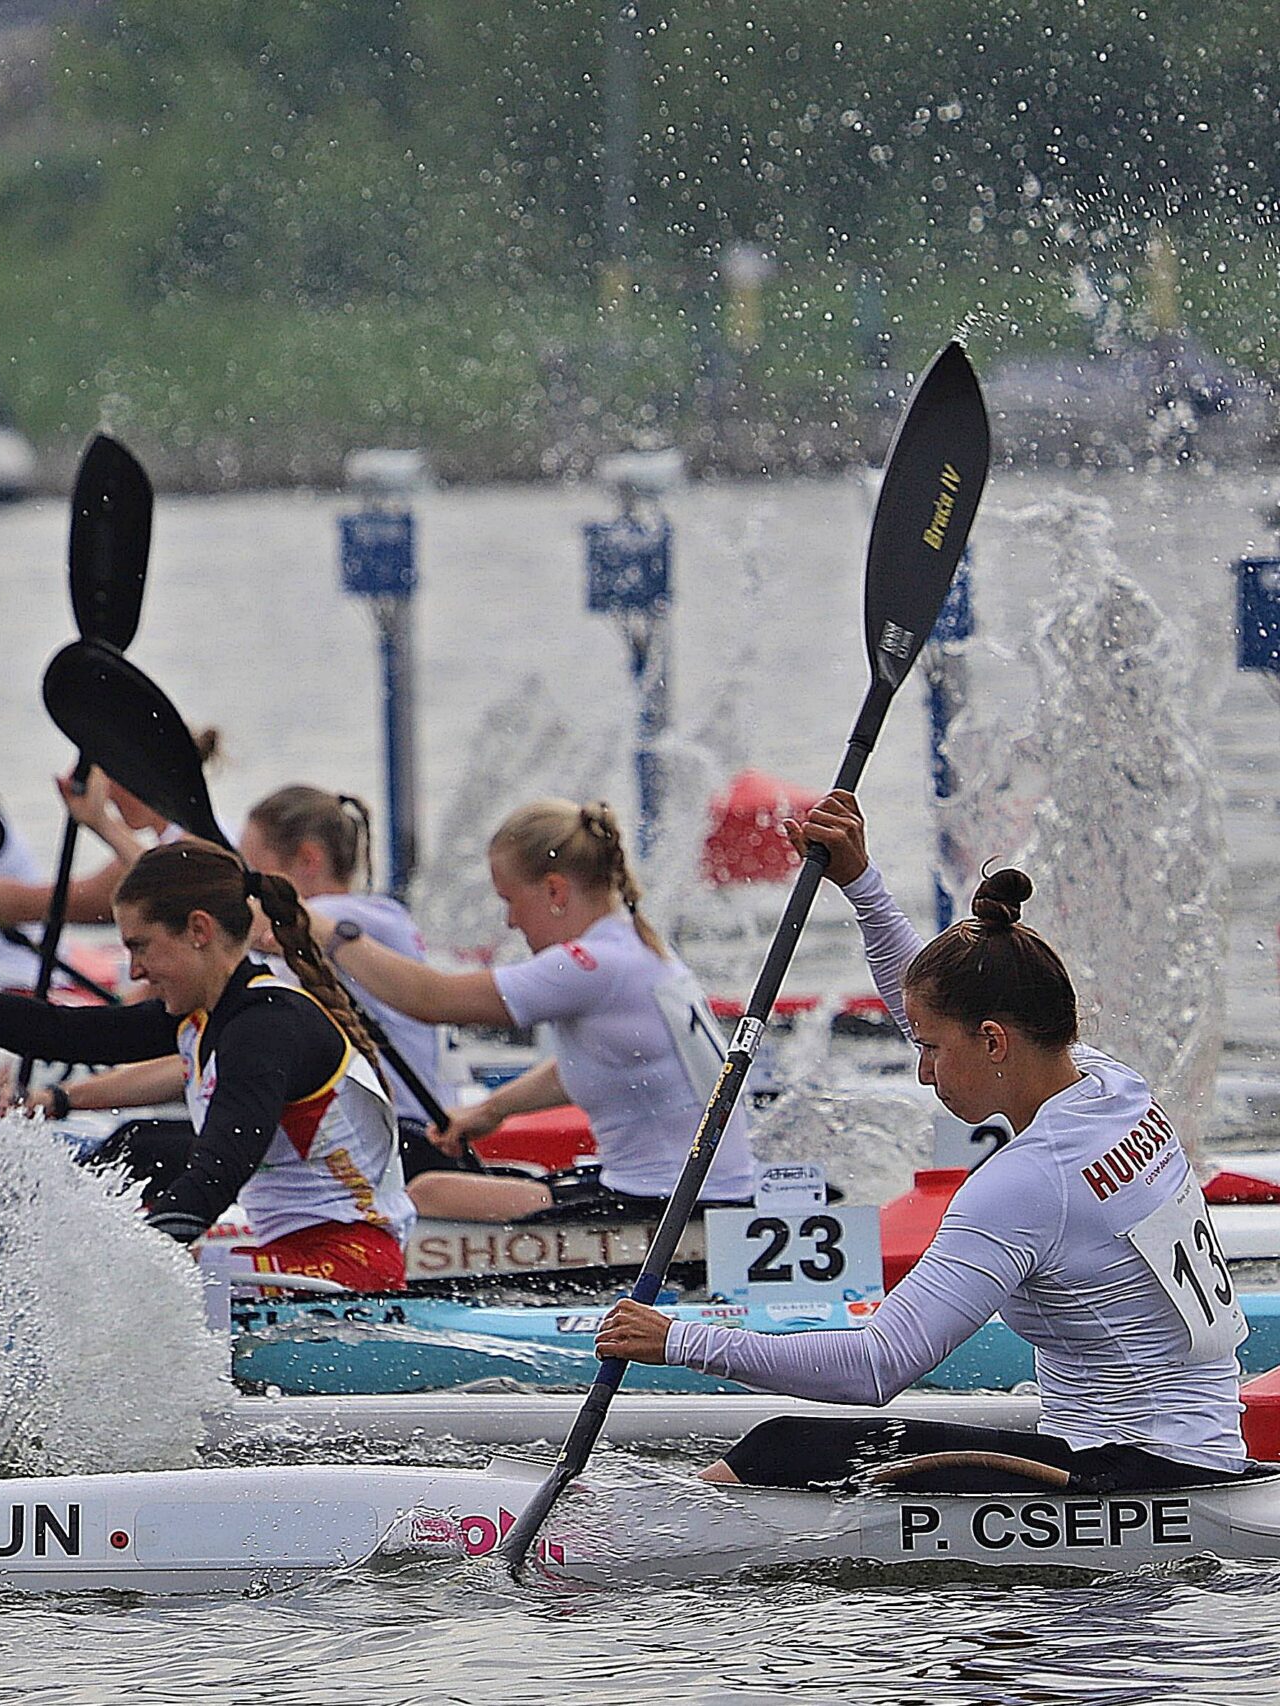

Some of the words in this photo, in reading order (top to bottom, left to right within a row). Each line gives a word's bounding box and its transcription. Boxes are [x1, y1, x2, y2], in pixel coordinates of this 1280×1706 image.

[939, 462, 961, 493] IV
[746, 1215, 845, 1282] 23
[1172, 1218, 1233, 1327] 13
[900, 1504, 950, 1551] P.
[971, 1498, 1193, 1550] CSEPE
